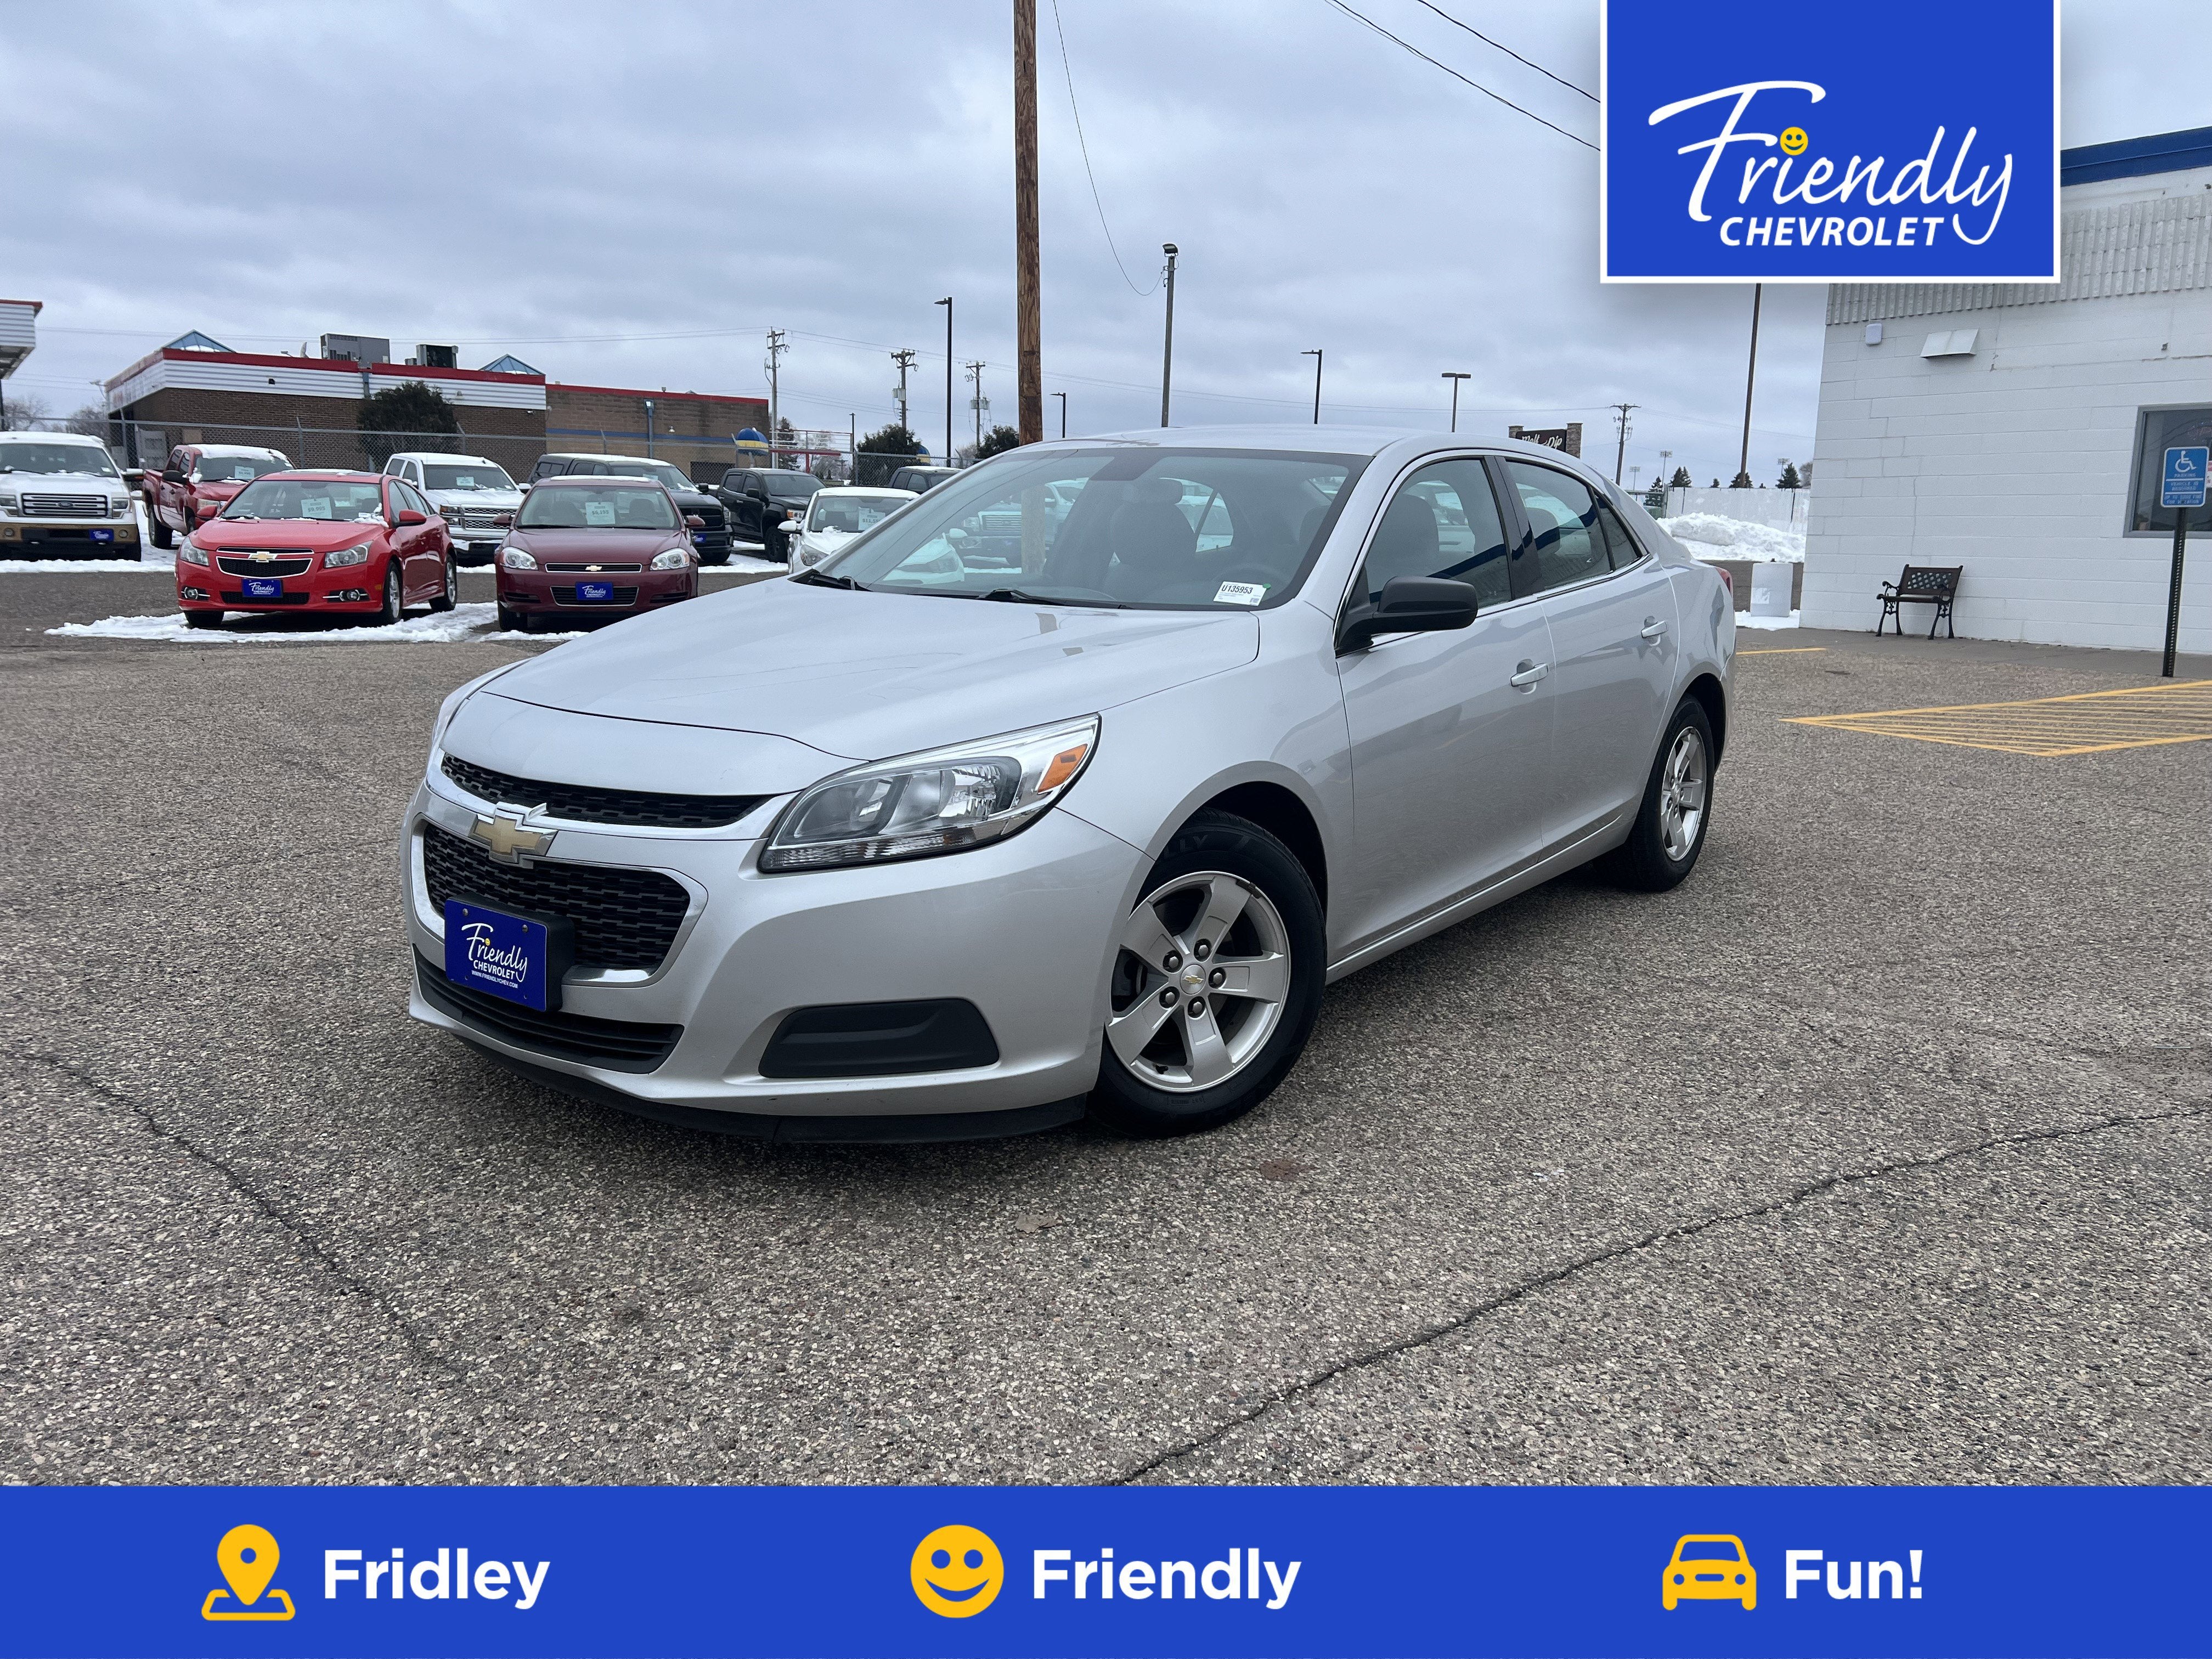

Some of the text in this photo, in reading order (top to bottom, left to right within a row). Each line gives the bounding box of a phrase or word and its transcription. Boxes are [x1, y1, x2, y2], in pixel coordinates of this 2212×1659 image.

[1221, 584, 1254, 594] U135953
[461, 923, 527, 983] Friendly
[473, 960, 515, 980] CHEVROLET
